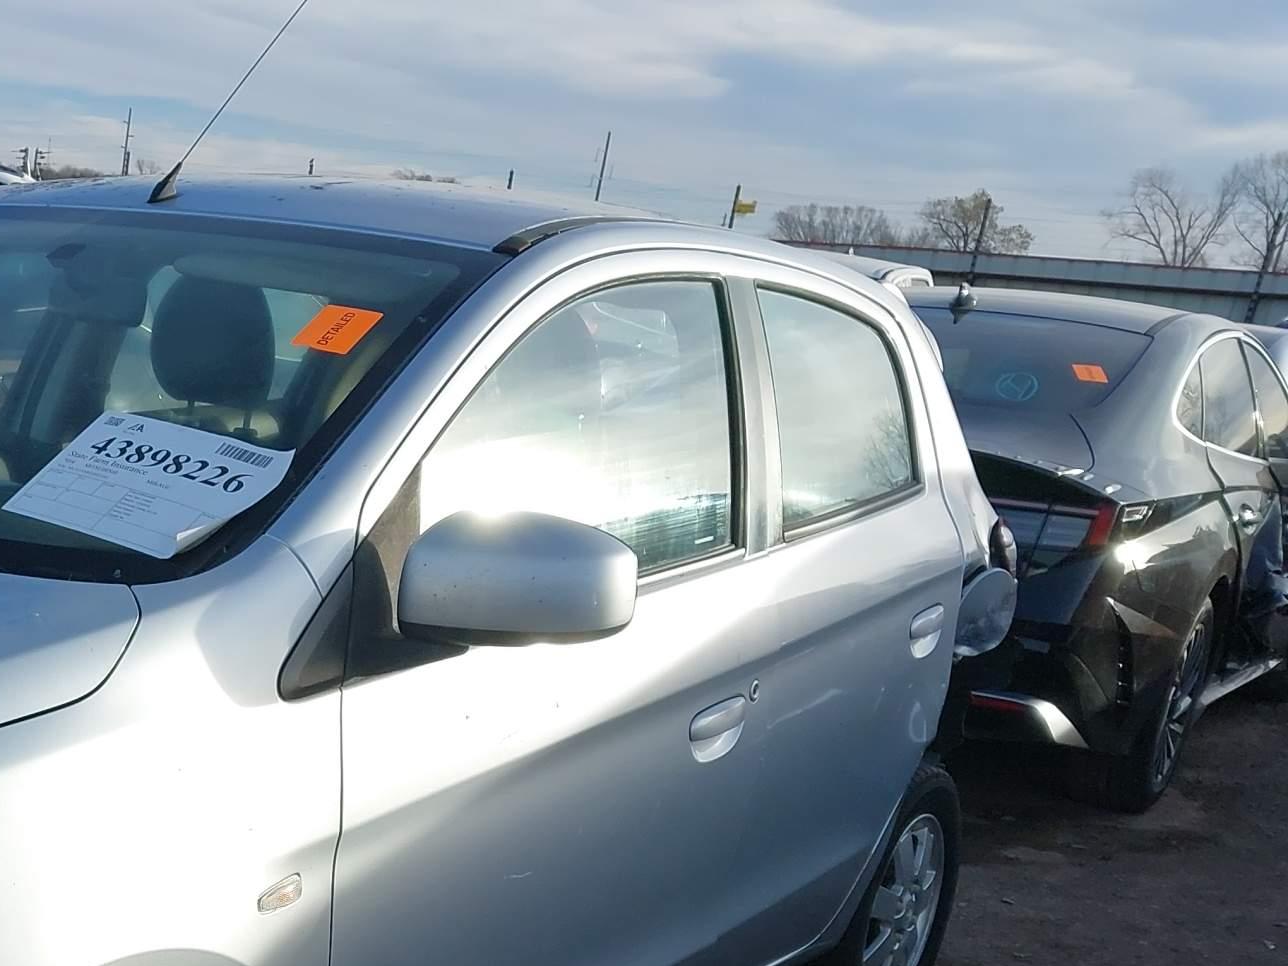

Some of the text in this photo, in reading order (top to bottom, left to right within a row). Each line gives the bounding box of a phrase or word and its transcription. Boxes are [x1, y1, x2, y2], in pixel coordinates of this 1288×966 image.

[317, 312, 356, 346] DETAILED
[91, 436, 254, 493] 43898226
[110, 460, 149, 475] Insurance
